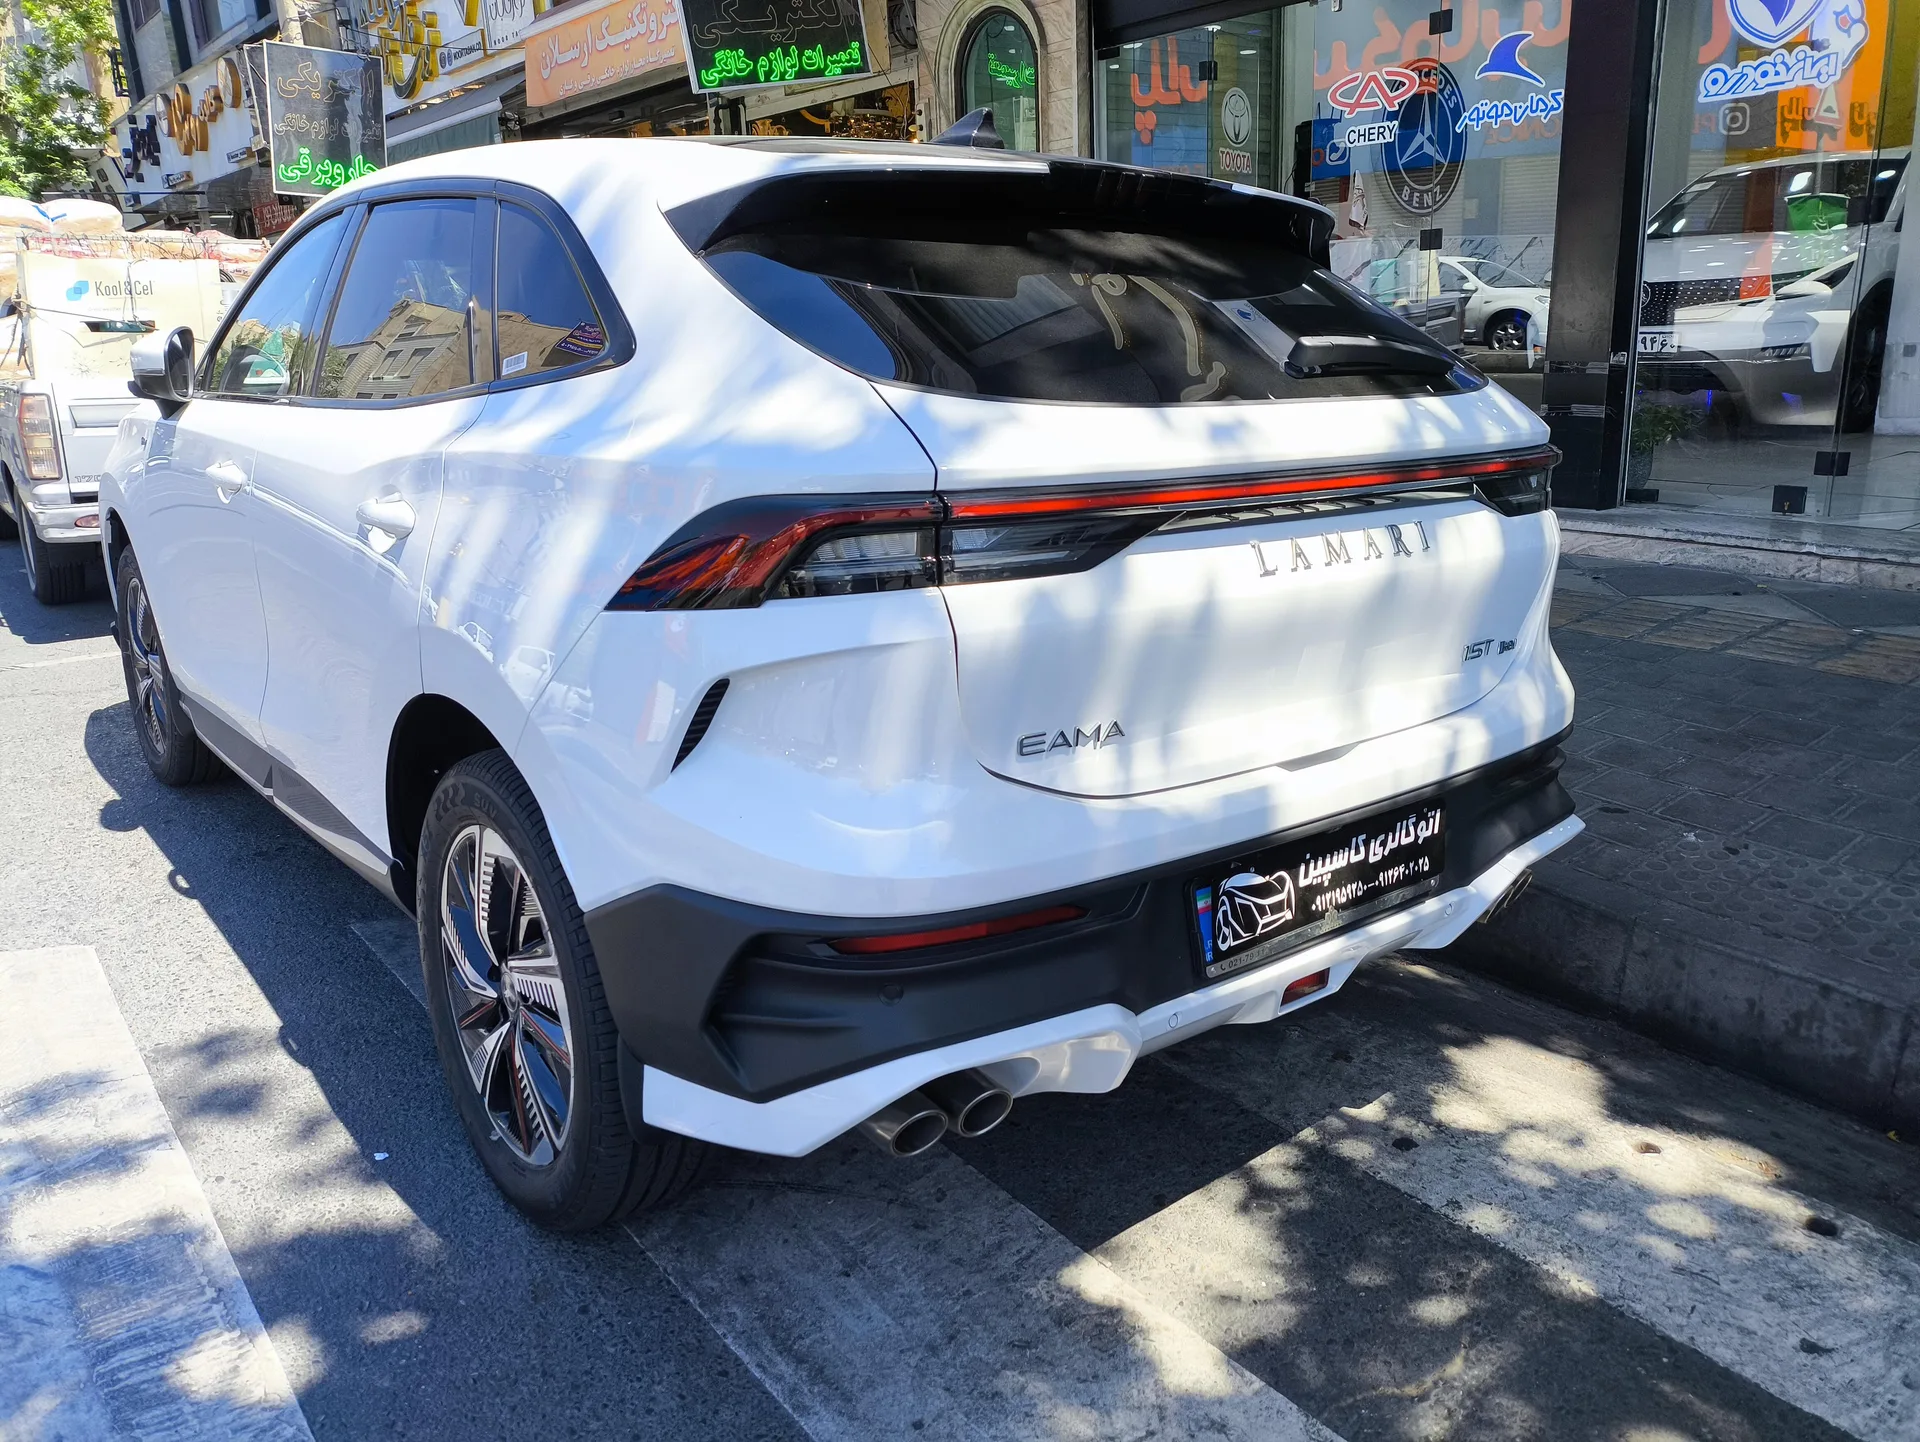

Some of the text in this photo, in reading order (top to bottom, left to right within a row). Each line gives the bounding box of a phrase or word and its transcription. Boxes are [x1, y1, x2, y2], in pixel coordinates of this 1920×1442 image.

[540, 24, 592, 80] ارسلان
[701, 41, 862, 87] تعمیرات لوازم خانگی
[274, 112, 310, 136] خانگی
[1347, 123, 1398, 145] CHERY
[1220, 151, 1252, 174] TOYOTA
[1401, 185, 1442, 207] BENZ
[1250, 519, 1432, 578] LAMARI
[1017, 719, 1126, 758] EAMA
[1299, 808, 1441, 887] اتوگالری کاسپین
